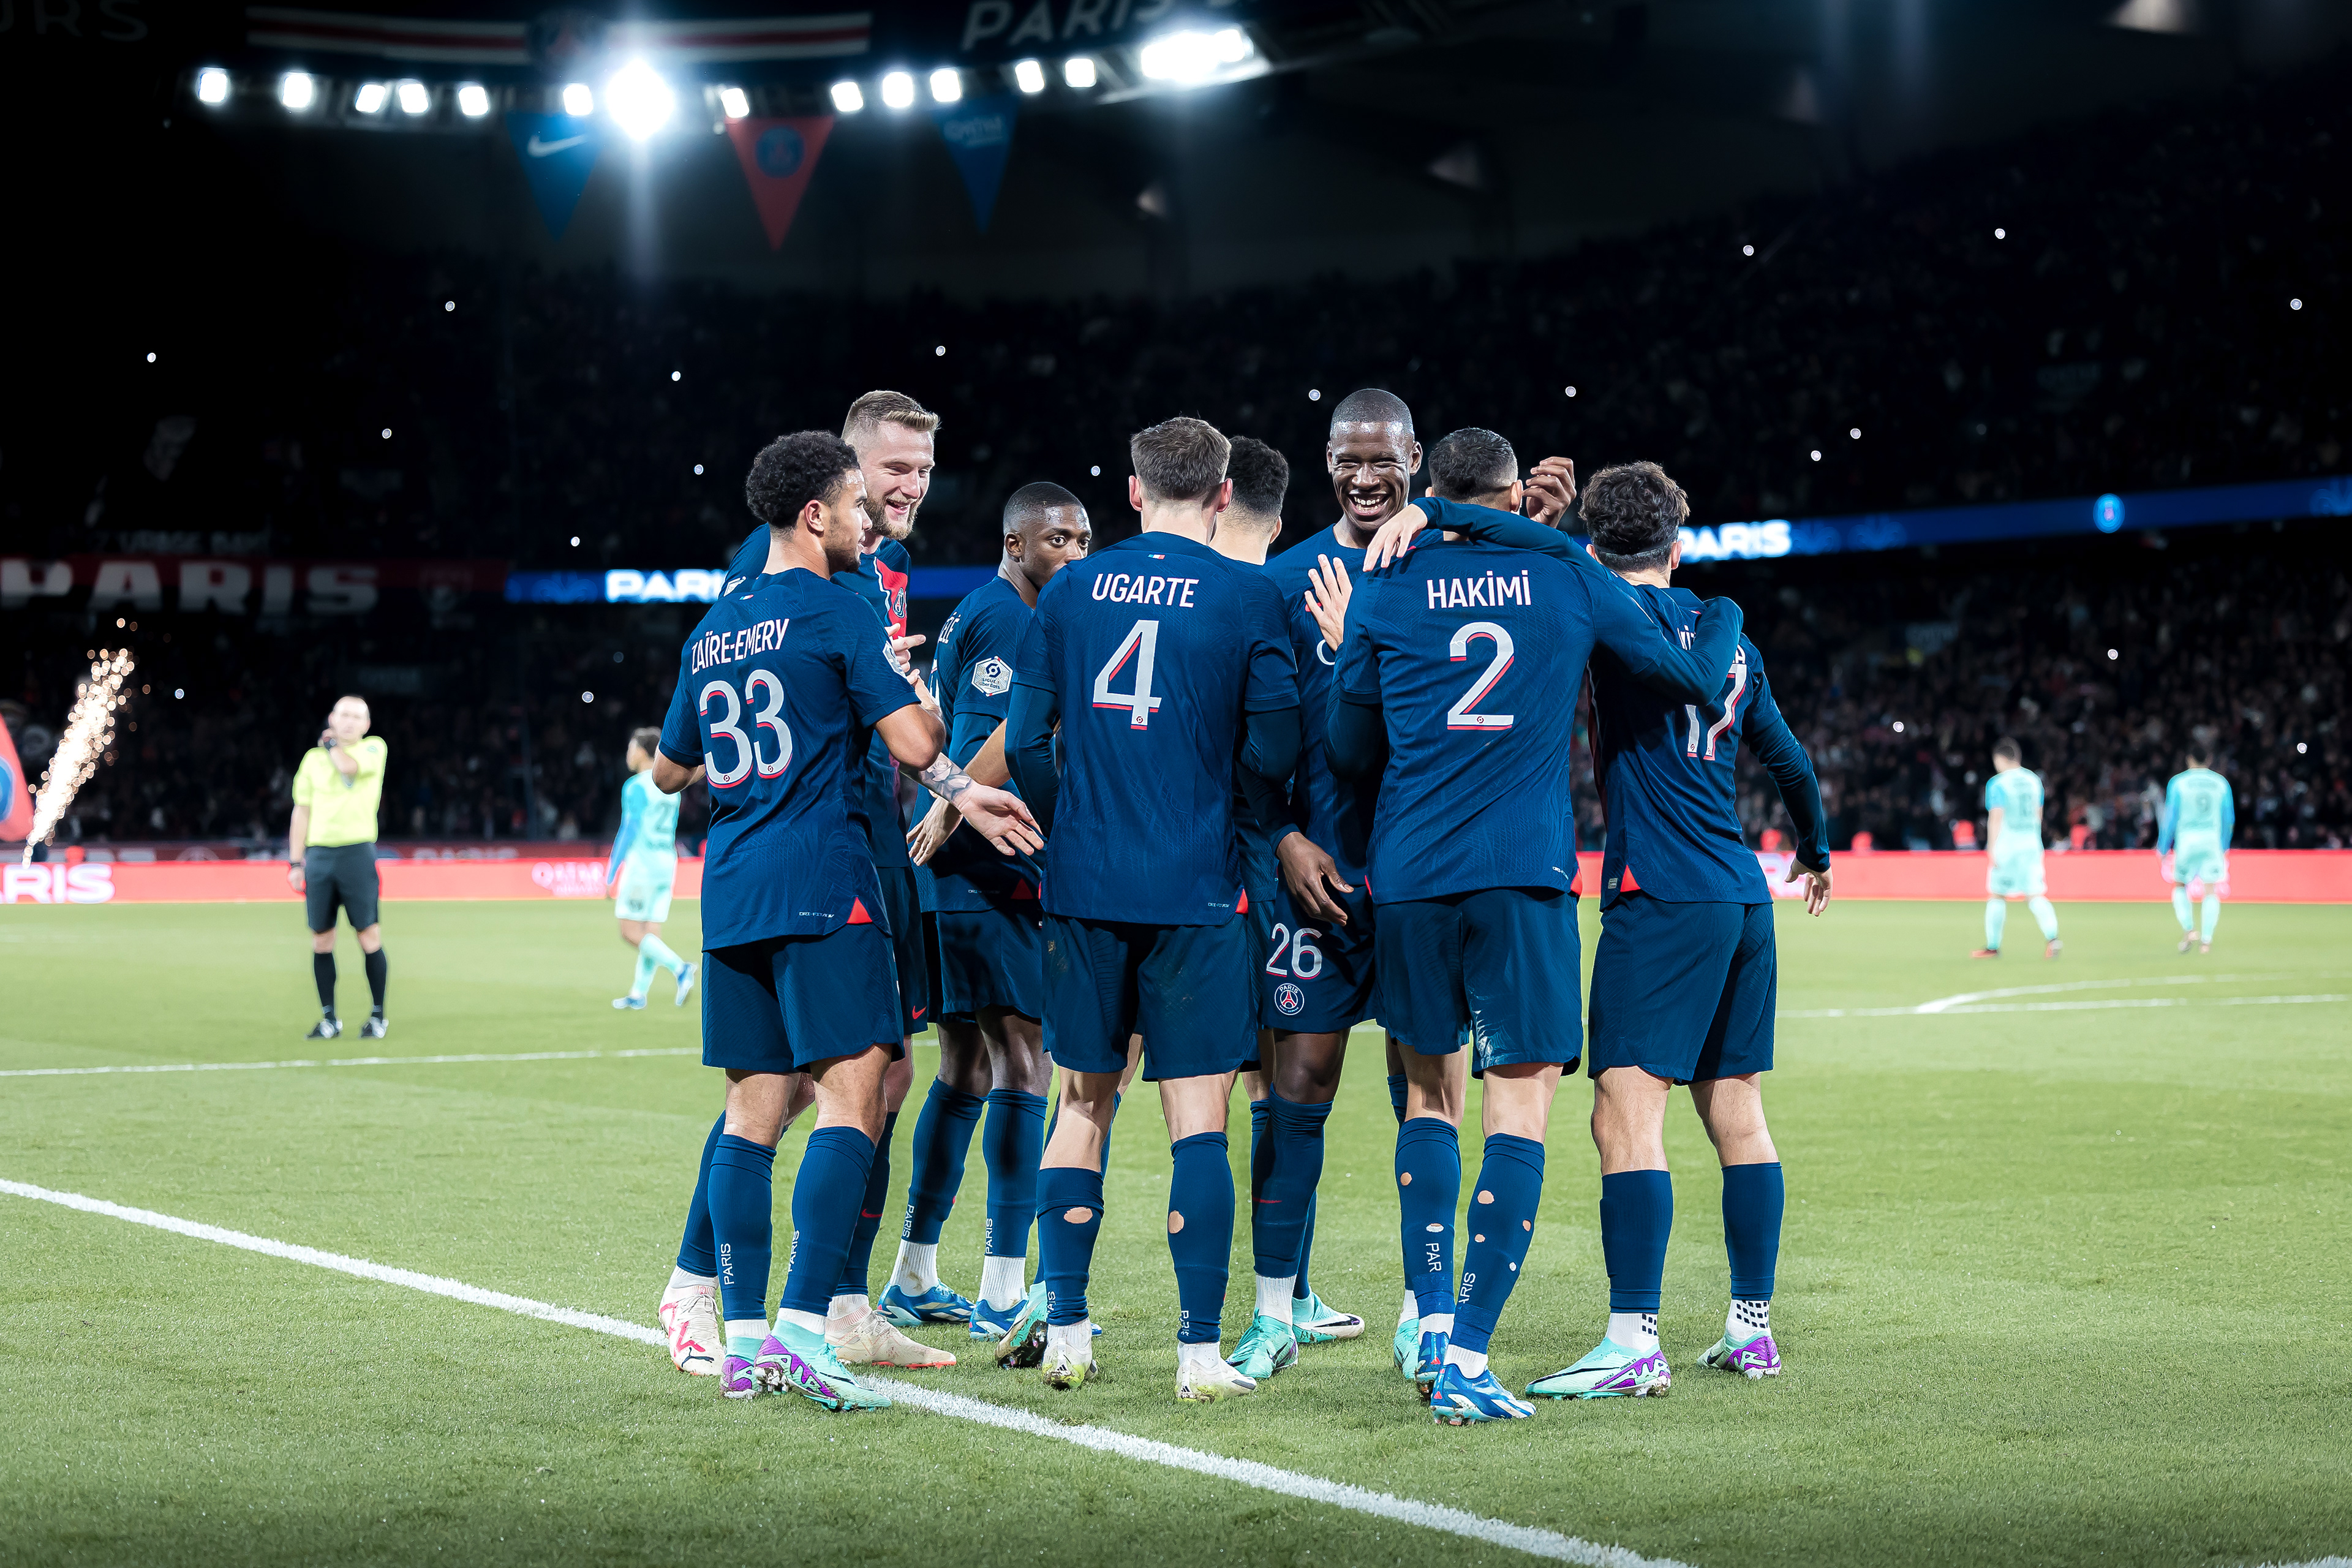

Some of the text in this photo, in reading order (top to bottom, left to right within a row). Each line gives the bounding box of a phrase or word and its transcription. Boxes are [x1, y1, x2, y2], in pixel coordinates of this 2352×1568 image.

[0, 559, 380, 614] PARIS
[606, 570, 729, 603] PARI
[1091, 573, 1199, 608] UGARTE
[691, 619, 790, 675] ZAÏRE-EMERY
[1093, 619, 1162, 730] 4
[1447, 622, 1514, 731] 2
[699, 669, 793, 788] 33
[1686, 665, 1747, 761] 17
[0, 864, 116, 905] RIS
[1266, 923, 1322, 980] 26
[1279, 985, 1299, 994] PARIS
[902, 1204, 914, 1238] PARIS
[720, 1243, 735, 1285] PARIS
[1425, 1243, 1442, 1273] PAR
[1458, 1272, 1476, 1304] ARIS
